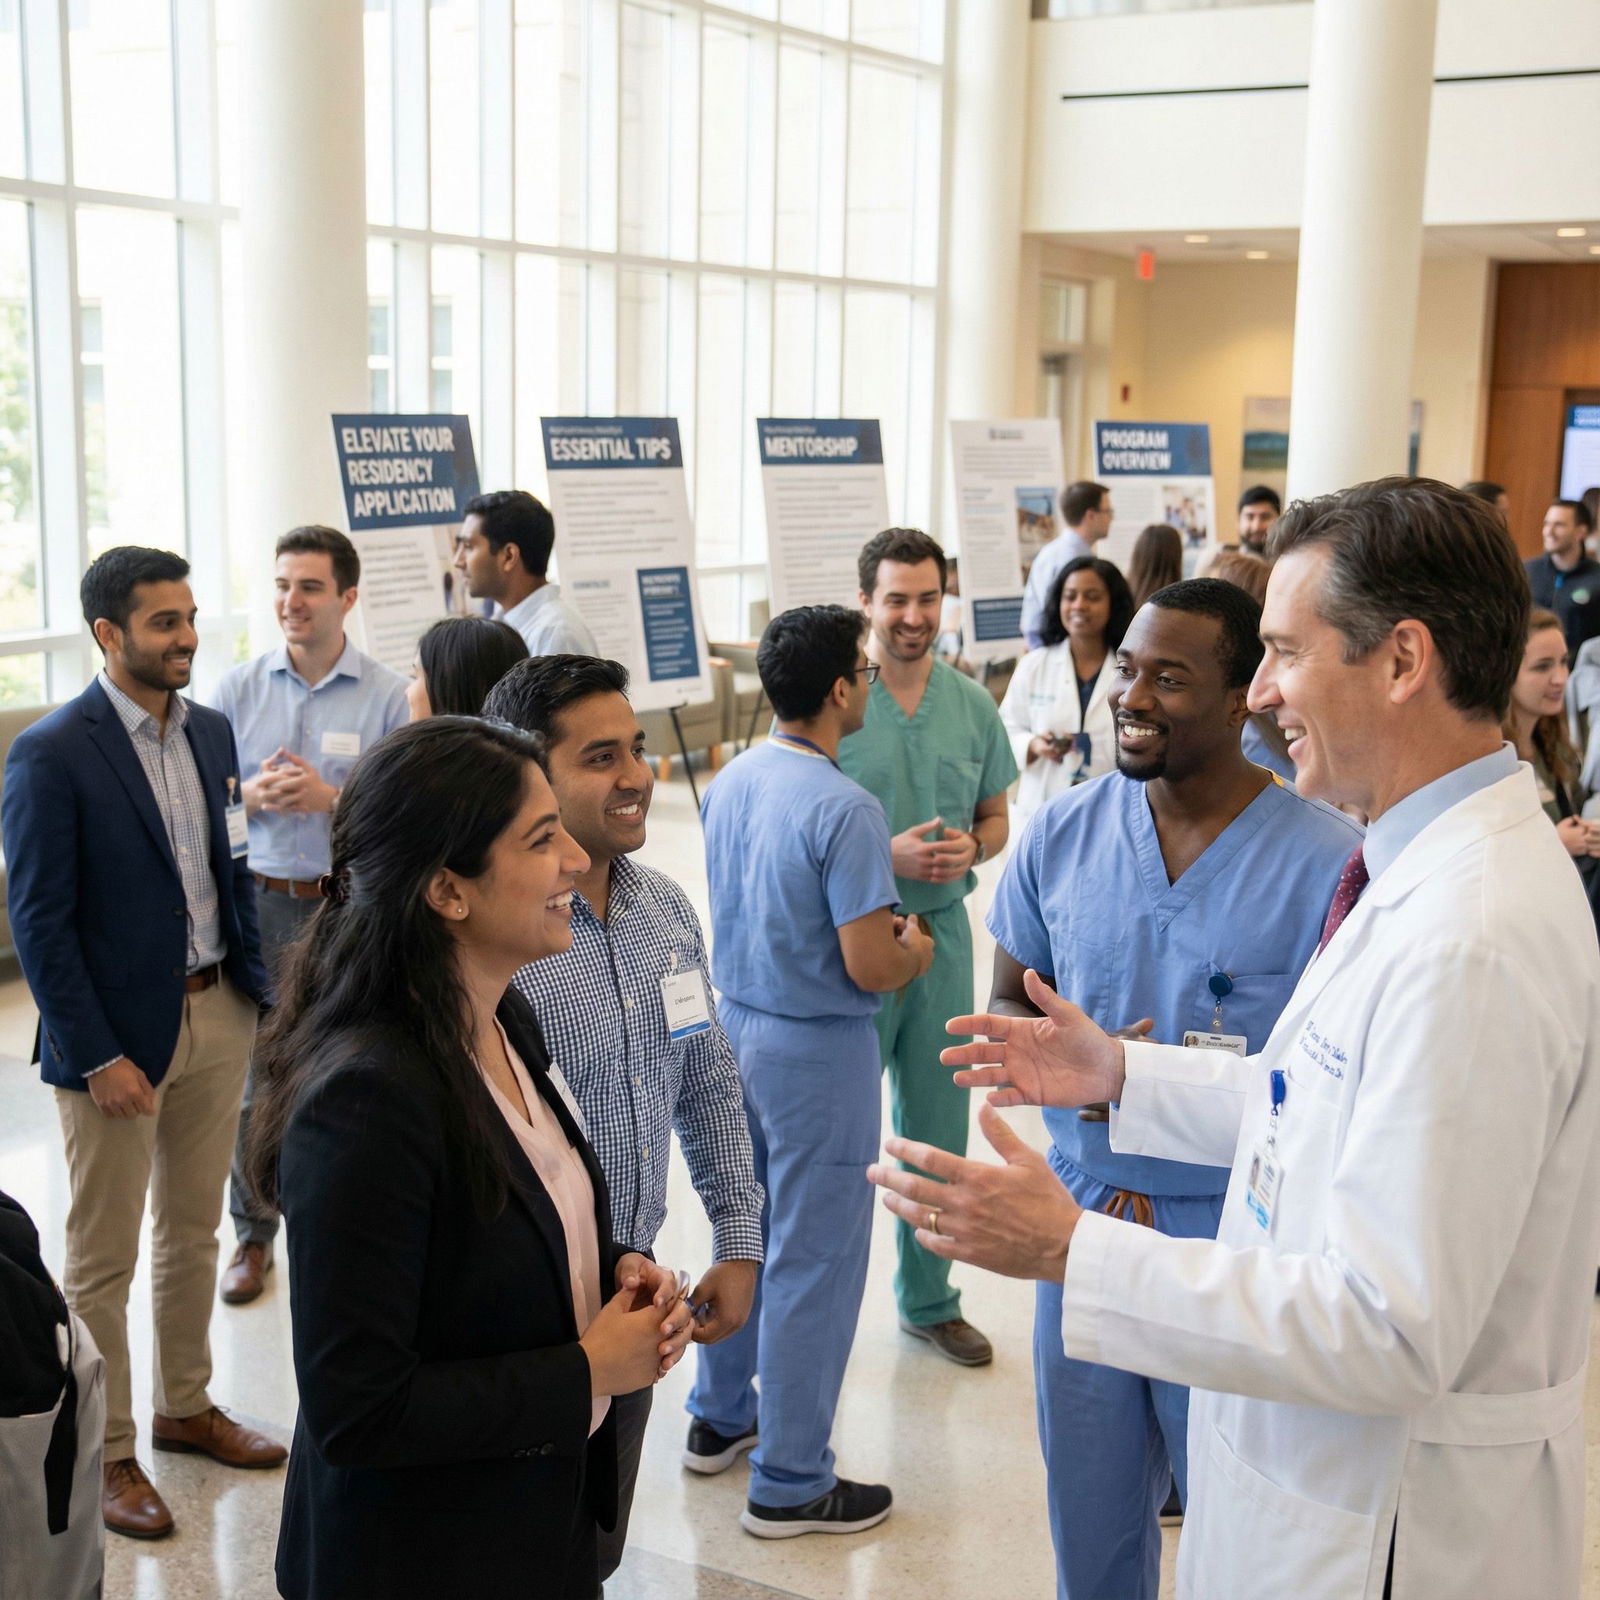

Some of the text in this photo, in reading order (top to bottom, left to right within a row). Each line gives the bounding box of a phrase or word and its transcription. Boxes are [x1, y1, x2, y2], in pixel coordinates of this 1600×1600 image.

[342, 426, 455, 454] ELEVATE YOUR
[550, 437, 672, 461] ESSENTIAL TIPS
[764, 437, 858, 457] MENTORSHIP
[1101, 430, 1169, 449] PROGRAM
[347, 458, 433, 485] RESIDENCY
[1102, 451, 1171, 470] OVERVIEW
[354, 488, 456, 517] APPLICATION
